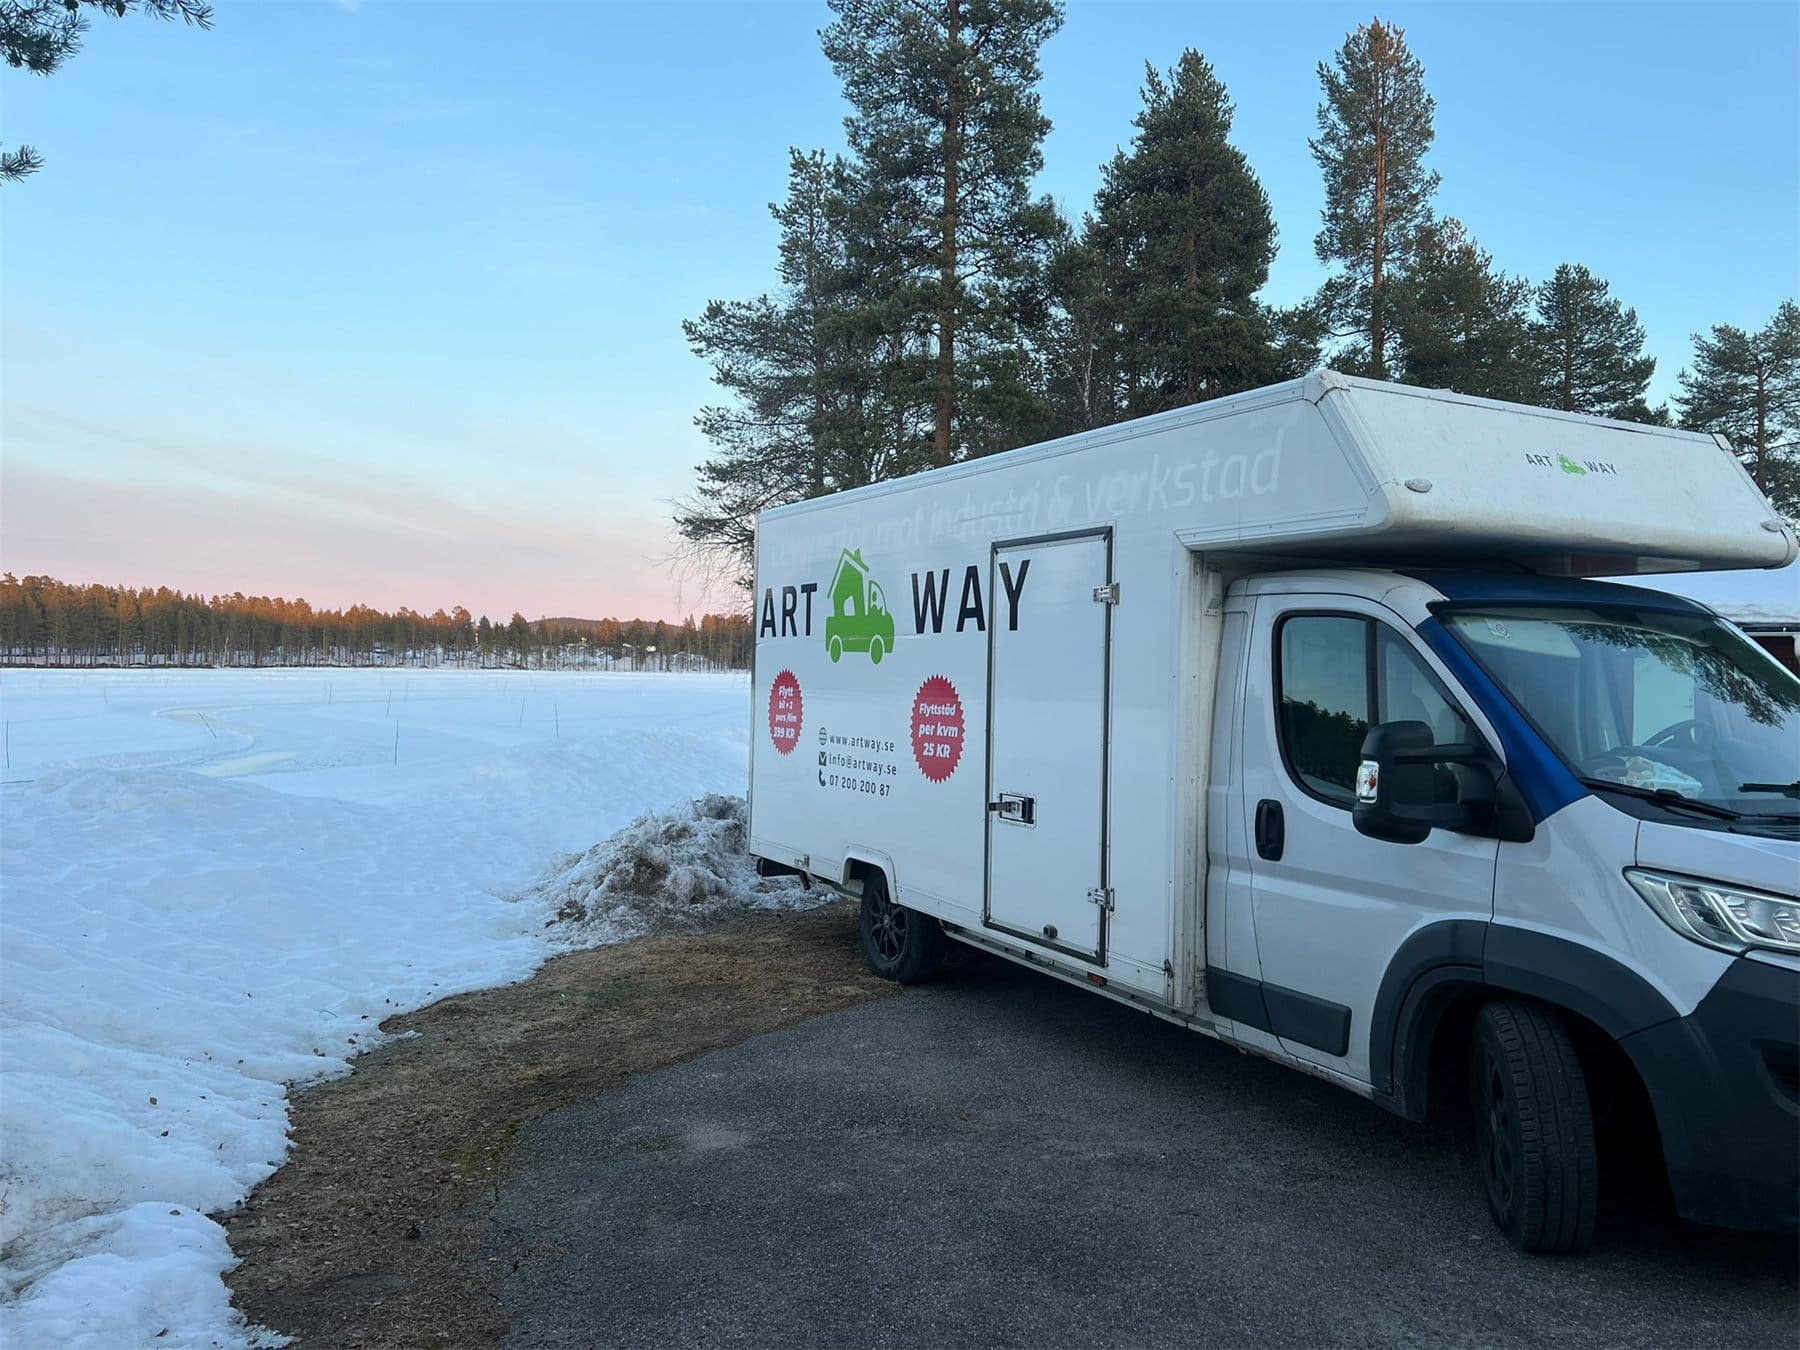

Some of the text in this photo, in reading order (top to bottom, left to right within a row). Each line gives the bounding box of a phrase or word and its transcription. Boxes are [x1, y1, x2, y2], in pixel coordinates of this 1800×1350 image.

[1525, 453, 1617, 474] ART WAY
[1085, 427, 1287, 520] verkstad
[760, 559, 1031, 638] ART WAY
[778, 685, 794, 699] Flytt
[919, 703, 957, 717] Flyttstäd
[918, 722, 959, 738] per kvm
[829, 735, 895, 752] www.artway.se
[923, 742, 951, 759] 25 KR
[829, 774, 890, 797] 07 200 200 87
